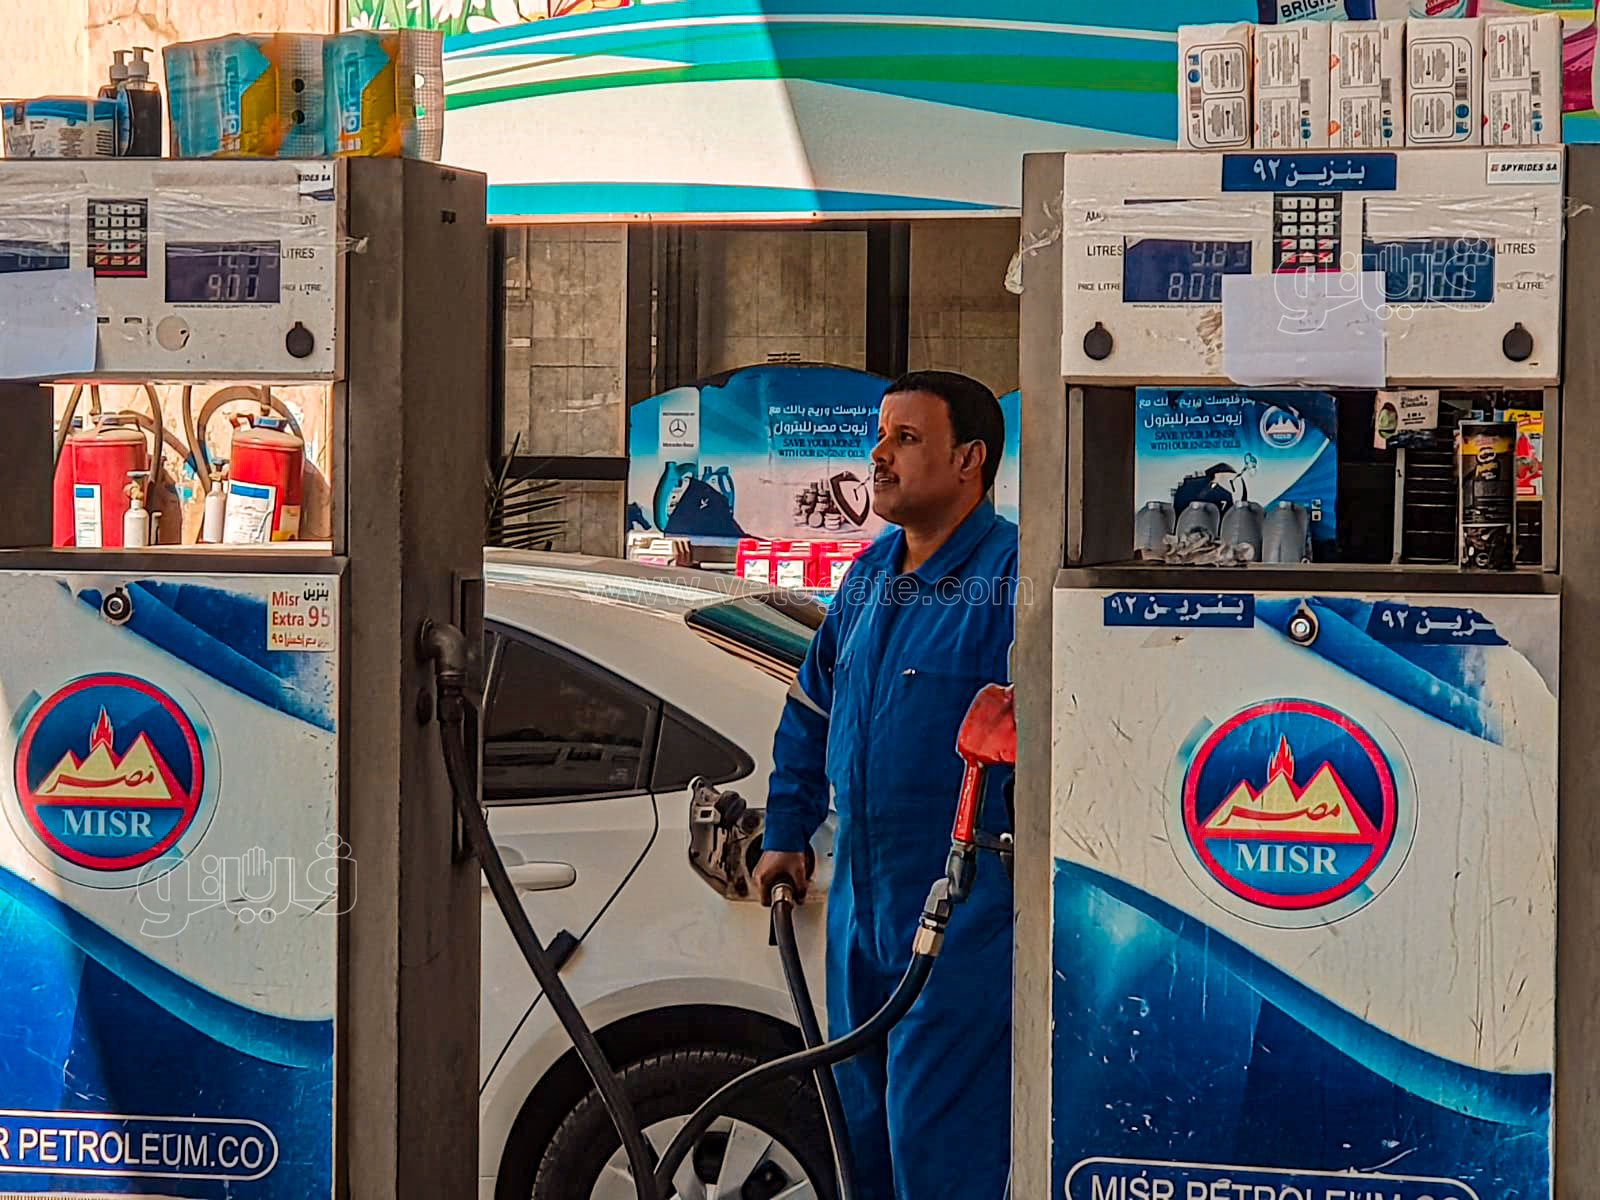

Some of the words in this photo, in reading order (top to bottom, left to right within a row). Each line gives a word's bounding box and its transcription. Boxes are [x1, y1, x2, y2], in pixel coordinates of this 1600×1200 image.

[1280, 0, 1337, 18] BRIG
[1253, 158, 1281, 181] ٩٢
[1285, 160, 1366, 187] بنزين
[1500, 163, 1544, 172] SPYRIDES
[1545, 163, 1558, 171] SA
[281, 247, 315, 259] LITRES
[1087, 245, 1123, 257] LITRES
[1497, 243, 1536, 255] LITRES
[208, 274, 259, 301] 9.00
[1517, 280, 1544, 290] LITRE
[1143, 413, 1184, 429] للبترول
[1184, 414, 1210, 427] مصر
[1212, 411, 1243, 426] زيوت
[773, 420, 812, 436] للبترول
[813, 421, 837, 436] مصر
[839, 420, 868, 436] زيوت
[272, 591, 300, 606] Misr
[303, 582, 329, 601] بنزين
[272, 610, 305, 626] Extra
[308, 605, 330, 627] 95
[1382, 609, 1409, 628] ٩٢
[1415, 609, 1496, 637] زين
[45, 770, 155, 794] مصر
[61, 809, 153, 838] MISR
[1216, 802, 1341, 827] مصر
[1235, 843, 1339, 875] MISR
[1091, 1174, 1175, 1200] MISR
